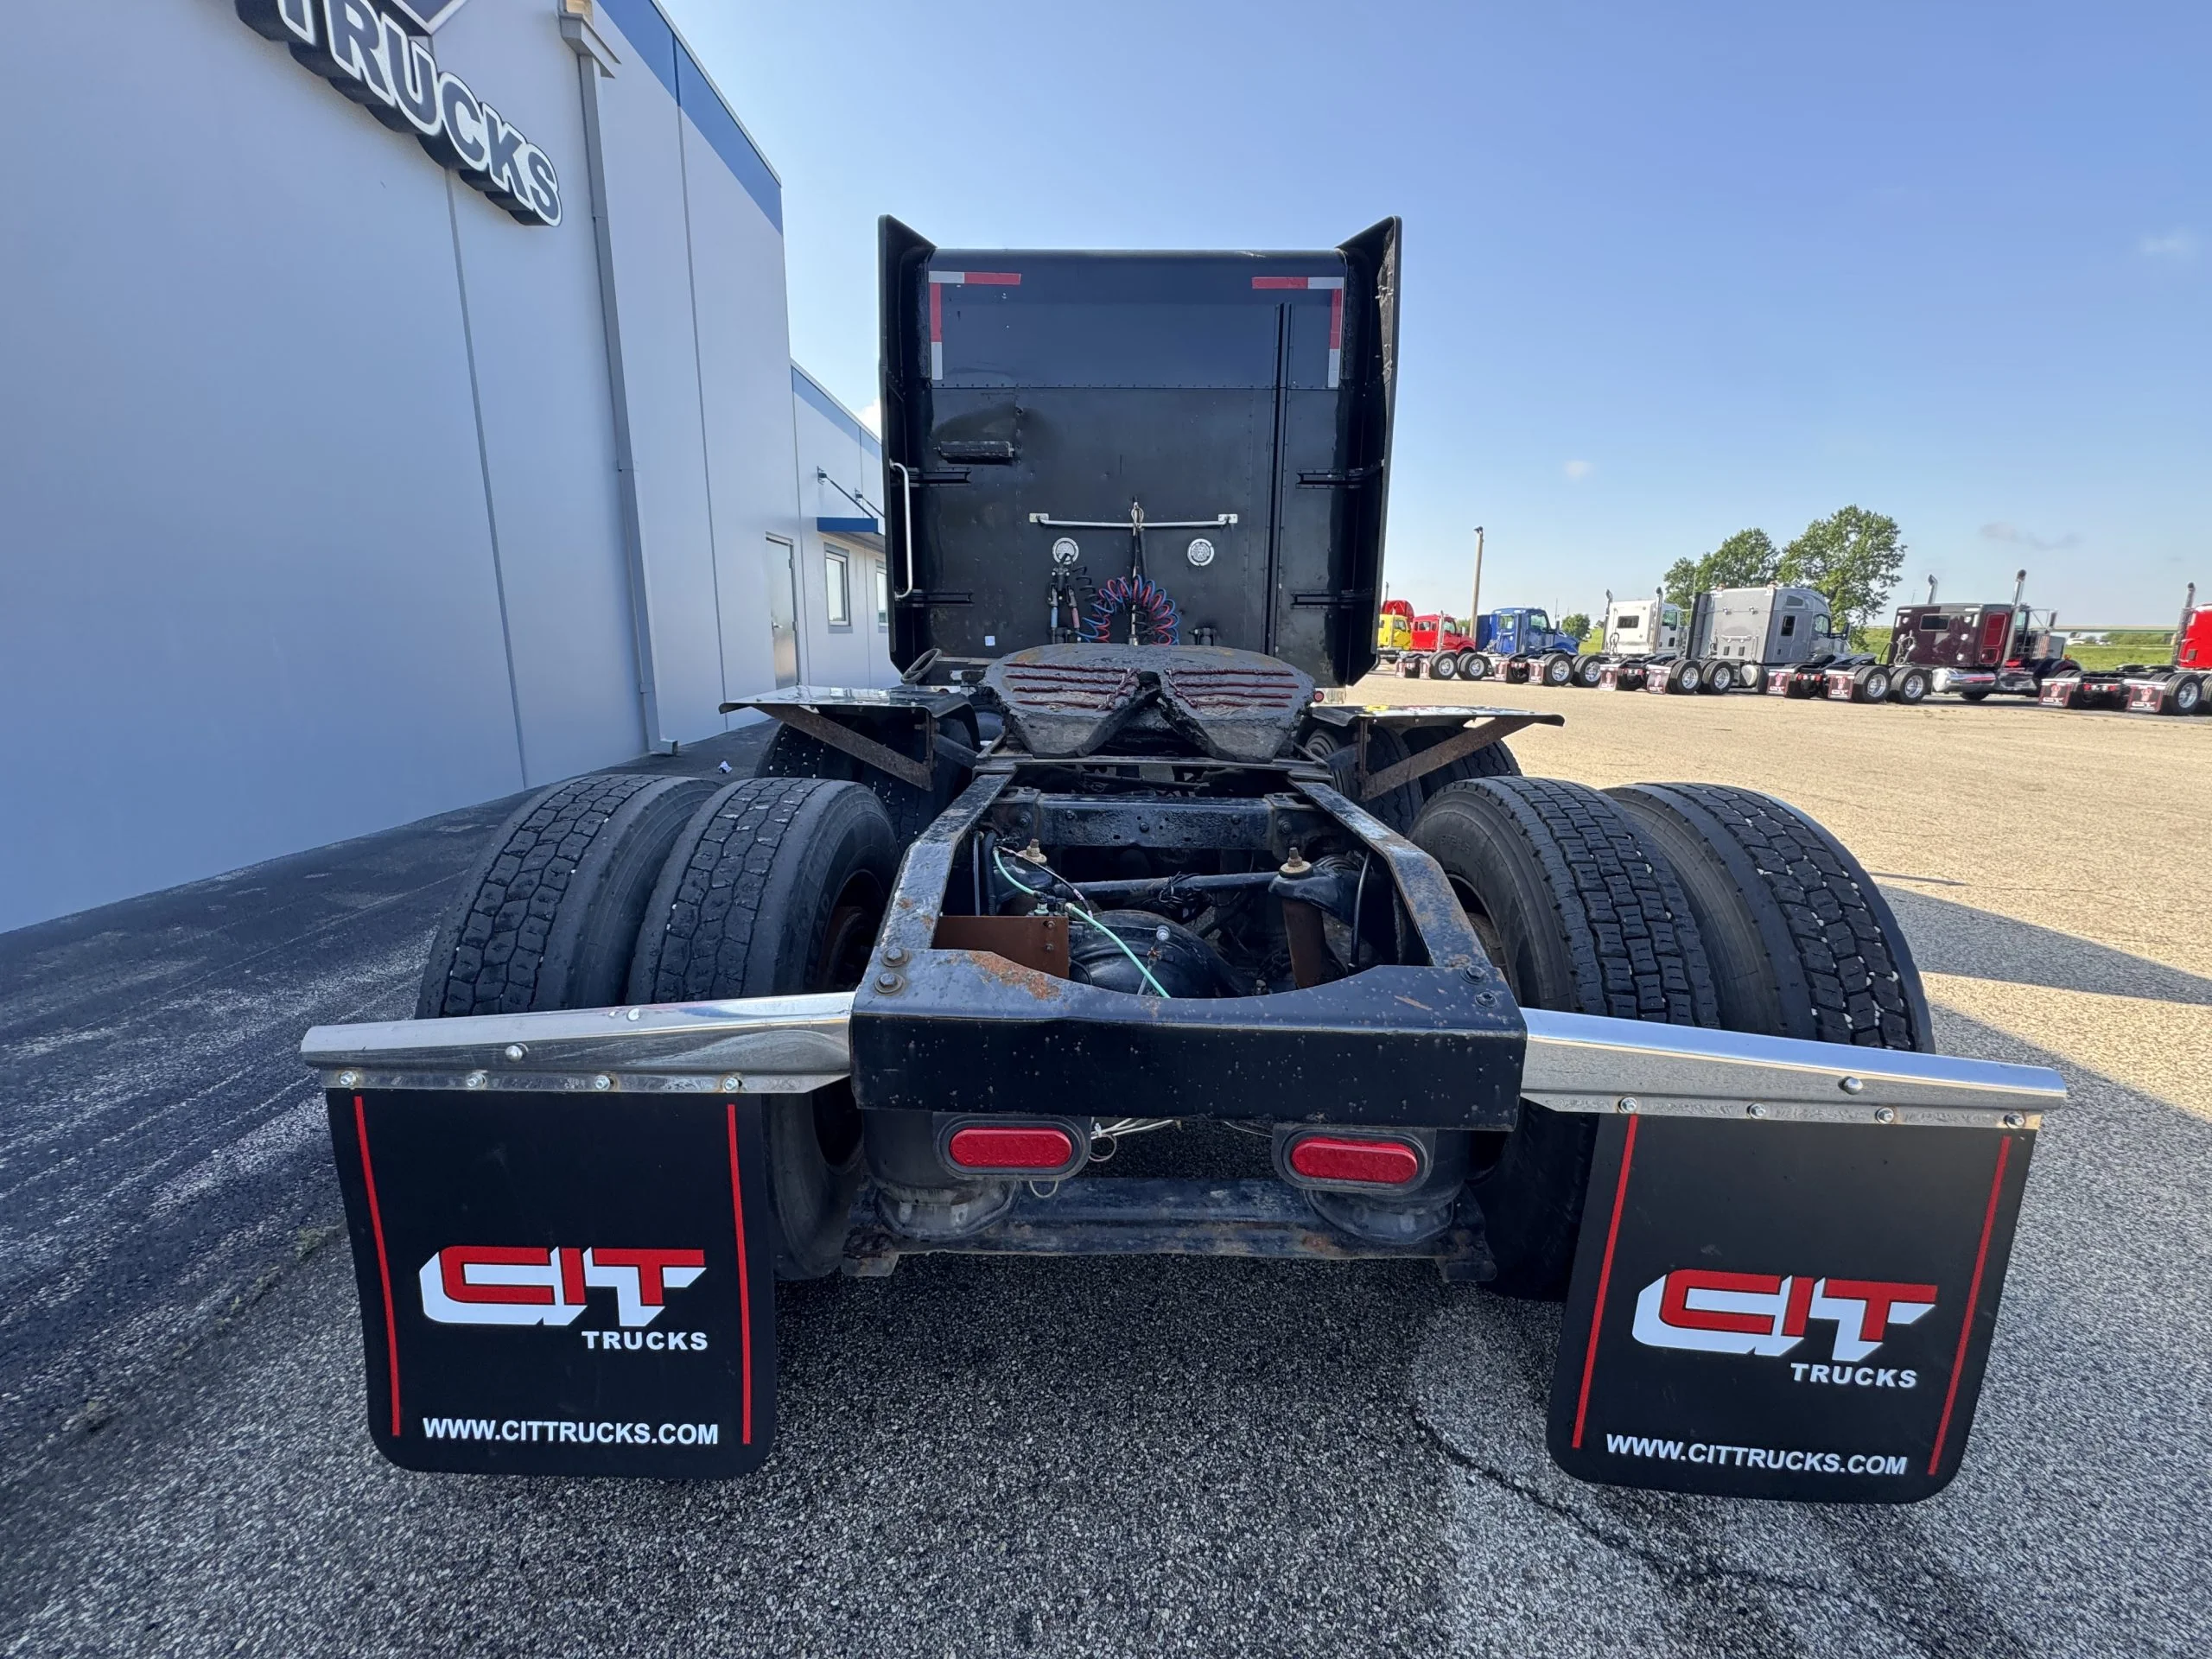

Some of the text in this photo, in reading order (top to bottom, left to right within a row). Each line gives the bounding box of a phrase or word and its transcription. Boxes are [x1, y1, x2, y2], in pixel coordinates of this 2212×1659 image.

[418, 1245, 707, 1327] CIT
[1631, 1268, 1938, 1362] CIT
[581, 1331, 709, 1351] TRUCKS
[1790, 1362, 1917, 1389] TRUCKS
[423, 1417, 718, 1445] WWW.CITTRUCKS.COM
[1605, 1433, 1908, 1475] WWW.CITTRUCKS.COM
